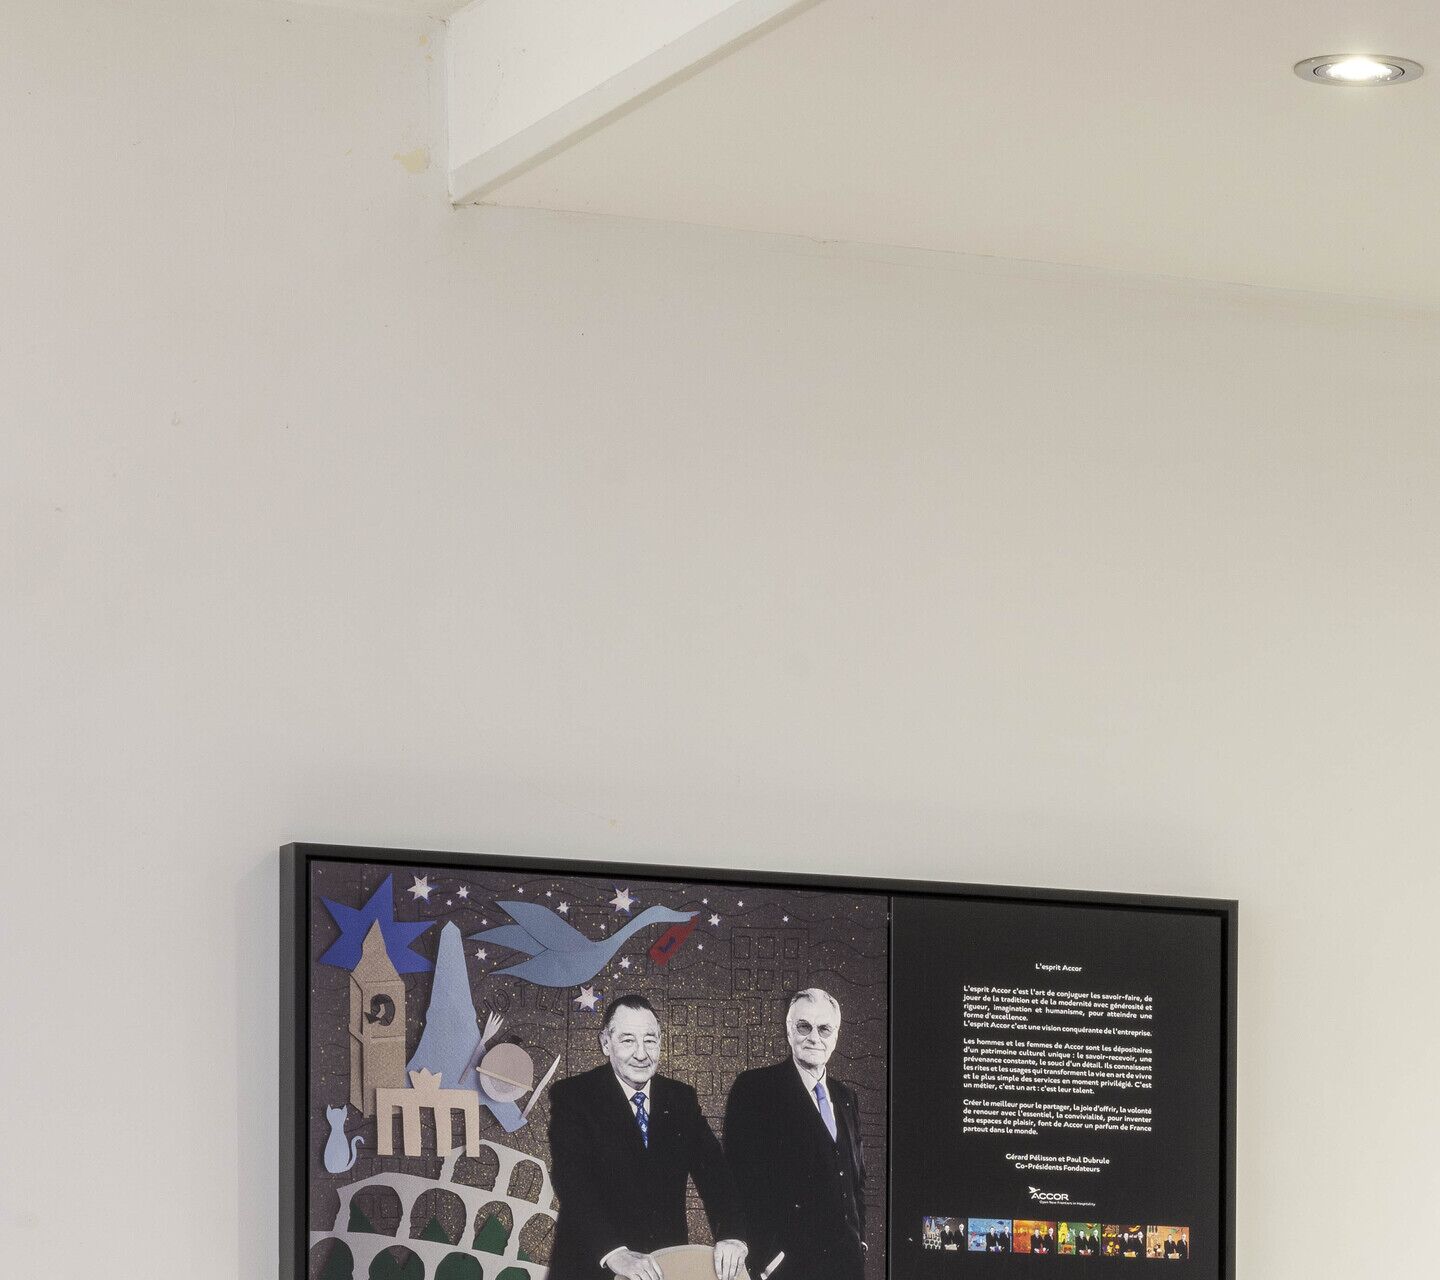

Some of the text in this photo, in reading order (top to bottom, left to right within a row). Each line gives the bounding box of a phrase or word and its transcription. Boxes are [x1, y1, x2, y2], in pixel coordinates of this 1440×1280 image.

[1035, 962, 1082, 973] L'esprit Accor
[963, 984, 989, 995] L'esprit
[991, 986, 1011, 994] Accor
[1012, 987, 1029, 995] c'est
[1030, 988, 1045, 996] l'art
[1056, 989, 1089, 1000] conjuguer
[962, 993, 981, 1004] jouer
[1000, 995, 1030, 1004] tradition
[1058, 998, 1092, 1007] modernité
[1109, 1001, 1144, 1012] générosité
[963, 1002, 990, 1013] rigueur,
[993, 1003, 1032, 1015] imagination
[1045, 1006, 1085, 1017] humanisme,
[1088, 1010, 1104, 1019] pour
[1106, 1009, 1137, 1018] atteindre
[963, 1011, 984, 1019] forme
[963, 1019, 989, 1030] L'esprit
[990, 1021, 1010, 1029] Accor
[1010, 1022, 1027, 1030] c'est
[1041, 1023, 1061, 1032] vision
[1062, 1024, 1103, 1036] conquérante
[976, 1037, 1004, 1046] hommes
[1026, 1040, 1053, 1049] femmes
[1064, 1042, 1084, 1050] Accor
[1085, 1043, 1100, 1051] sont
[963, 1046, 978, 1054] d'un
[980, 1047, 1017, 1058] patrimoine
[1018, 1048, 1046, 1057] culturel
[1047, 1050, 1071, 1060] unique
[963, 1055, 1002, 1066] prévenance
[1003, 1056, 1038, 1067] constante,
[1047, 1059, 1064, 1067] souci
[1065, 1059, 1081, 1068] d'un
[1081, 1060, 1103, 1069] détail.
[1113, 1062, 1152, 1071] connaissent
[974, 1064, 989, 1072] rites
[1009, 1067, 1031, 1076] usages
[1135, 1071, 1152, 1080] vivre
[973, 1081, 997, 1091] métier,
[998, 1082, 1015, 1091] c'est
[1040, 1084, 1057, 1093] c'est
[1057, 1085, 1071, 1093] leur
[1072, 1086, 1095, 1094] talent.
[980, 1073, 995, 1083] plus
[997, 1074, 1019, 1084] simple
[1033, 1075, 1060, 1084] services
[1071, 1077, 1099, 1086] moment
[1100, 1078, 1133, 1090] privilégié.
[1134, 1080, 1152, 1088] C'est
[963, 1098, 1152, 1114] Créer meilleur pour partager, joie d'offrir, volonté
[976, 1118, 1002, 1127] espaces
[1012, 1118, 1036, 1128] plaisir,
[1037, 1119, 1052, 1127] font
[1063, 1120, 1083, 1128] Accor
[1094, 1121, 1119, 1132] parfum
[1129, 1123, 1152, 1131] France
[1107, 1115, 1123, 1124] pour
[1124, 1114, 1152, 1123] inventer
[963, 1124, 1038, 1135] partout dans monde.
[1005, 1152, 1110, 1164] Gérard Pélisson Paul Dubrule
[1063, 1163, 1100, 1173] Fondateurs
[1031, 1192, 1069, 1201] ACCOR
